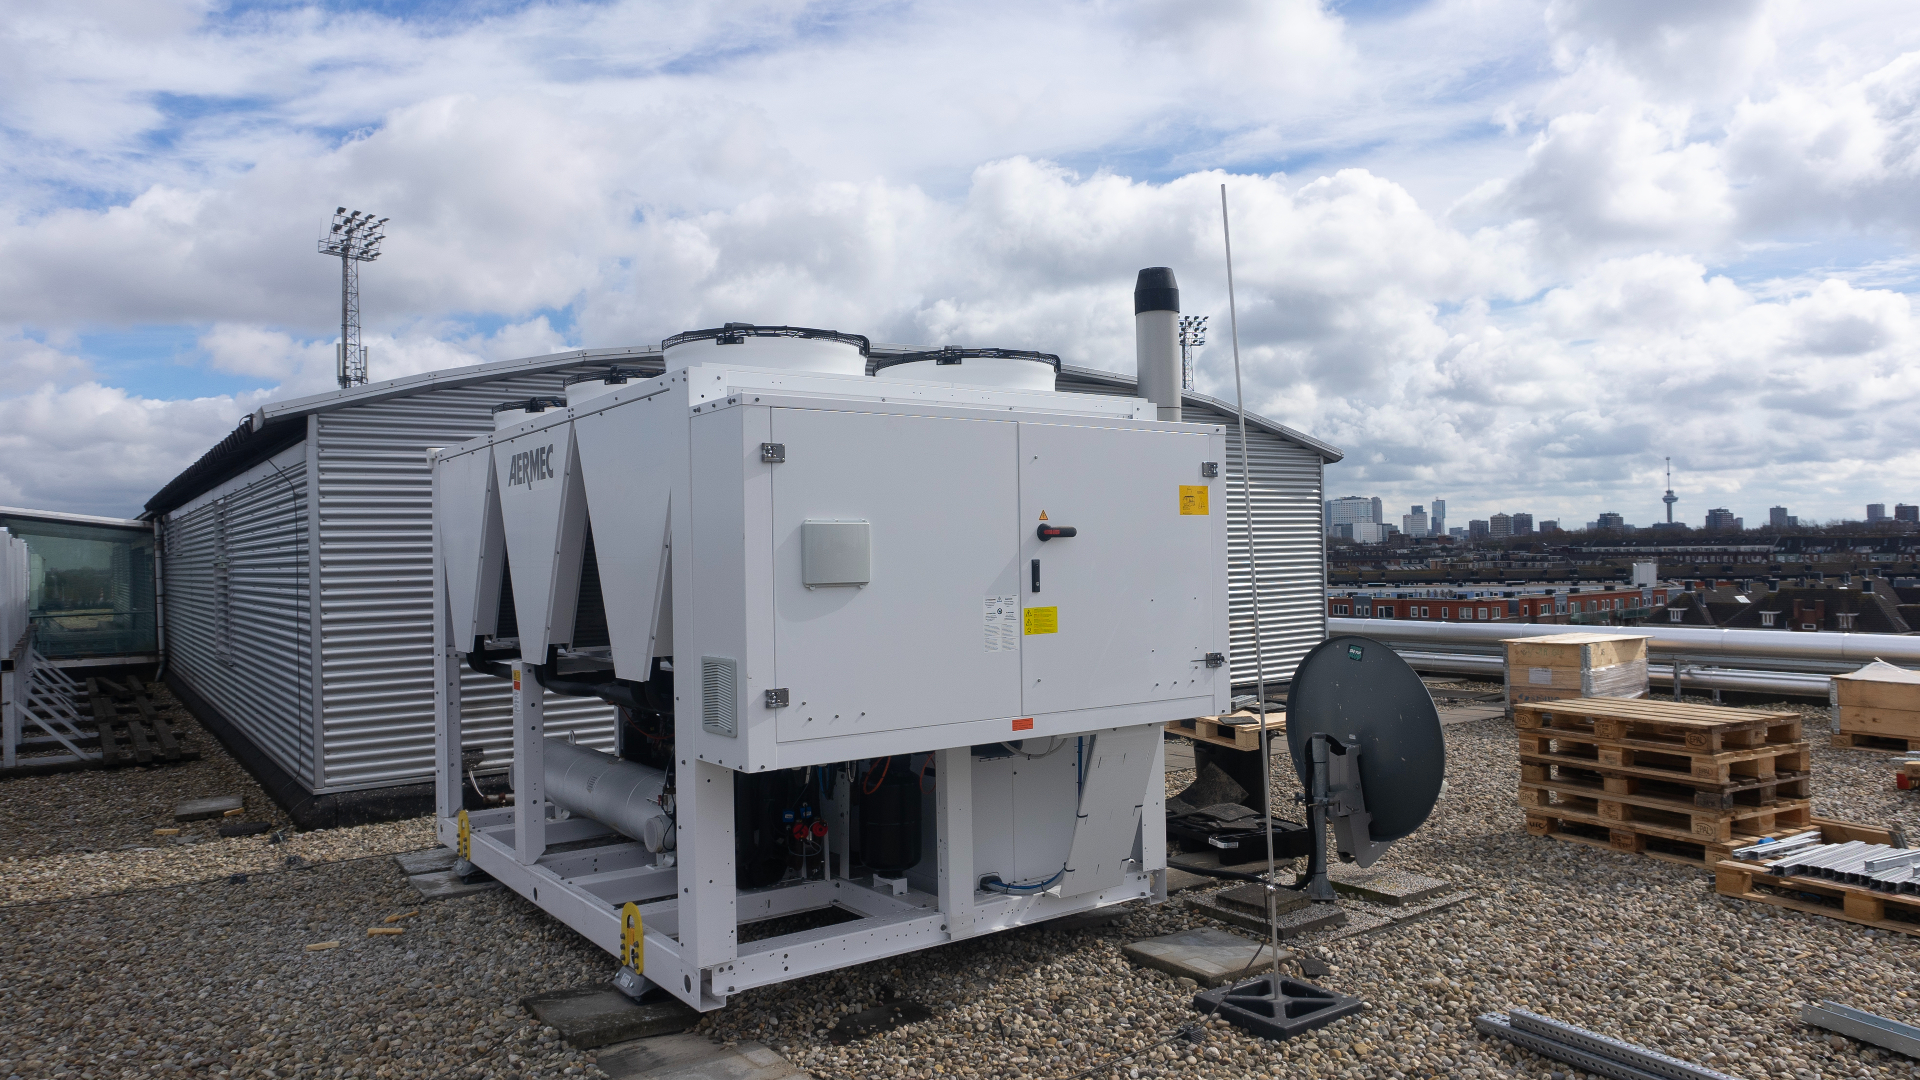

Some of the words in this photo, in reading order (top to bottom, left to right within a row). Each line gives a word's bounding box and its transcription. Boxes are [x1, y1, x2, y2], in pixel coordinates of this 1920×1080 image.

[508, 443, 554, 491] AERMEC
[1689, 735, 1704, 744] EPAL
[1696, 824, 1711, 836] EPAL
